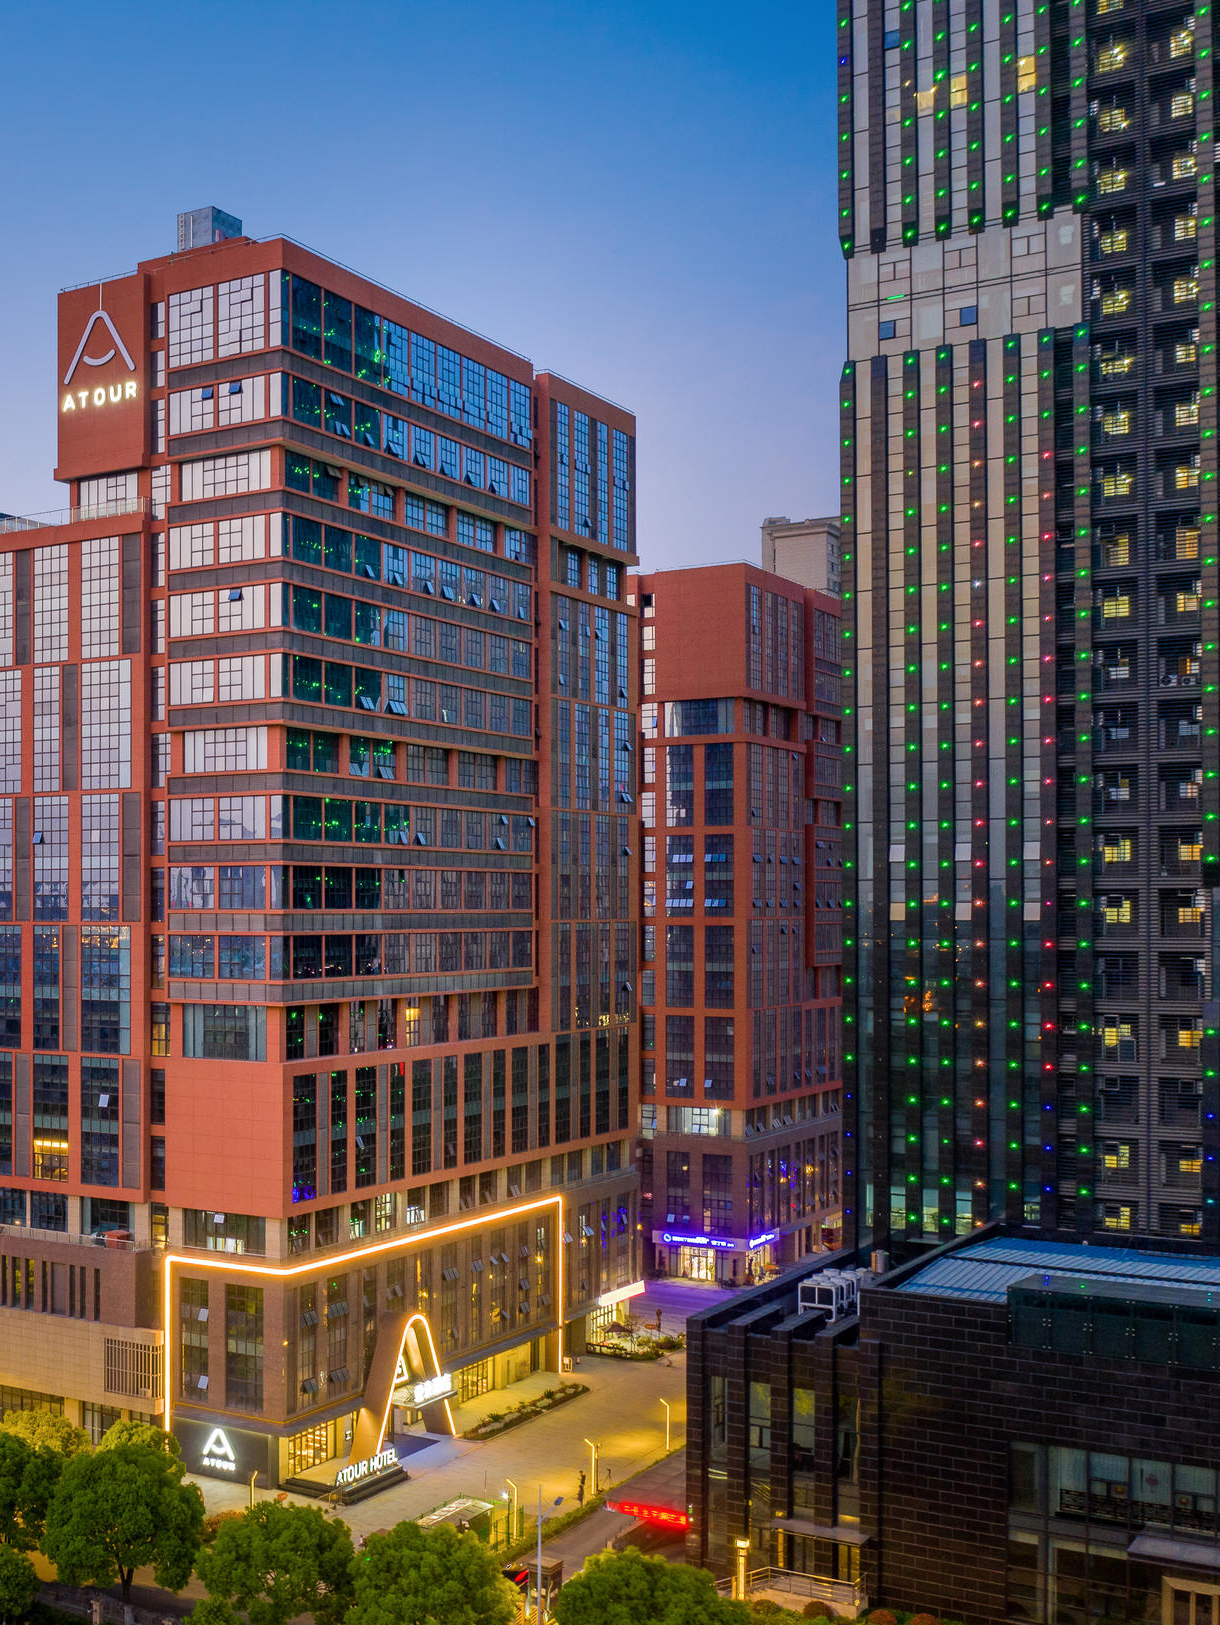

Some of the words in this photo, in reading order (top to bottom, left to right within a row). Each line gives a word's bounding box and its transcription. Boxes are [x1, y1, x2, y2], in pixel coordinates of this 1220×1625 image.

[62, 381, 137, 412] ATOUR
[335, 1460, 368, 1487] ATOUR
[369, 1447, 399, 1473] HOTEL
